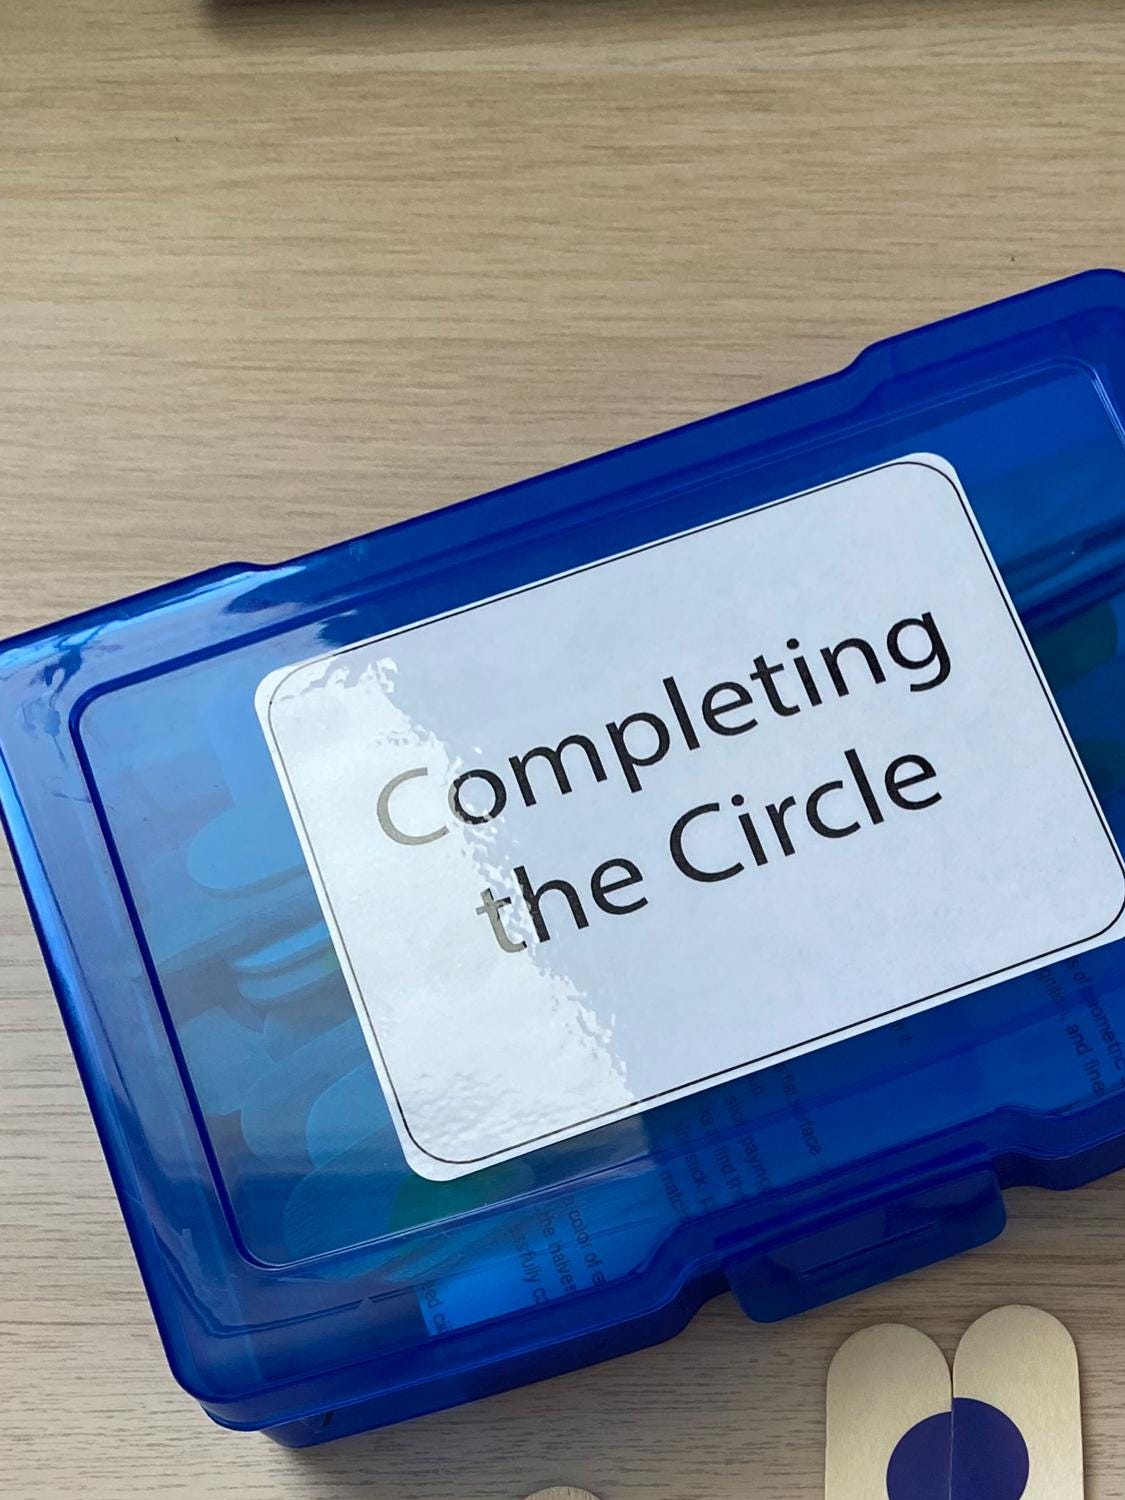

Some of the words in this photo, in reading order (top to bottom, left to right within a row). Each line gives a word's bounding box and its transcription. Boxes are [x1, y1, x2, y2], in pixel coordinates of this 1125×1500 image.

[375, 610, 952, 846] Completing
[475, 858, 649, 955] the
[668, 748, 943, 884] Circle
[1066, 1024, 1093, 1056] and
[567, 1209, 593, 1249] color
[583, 1251, 604, 1269] of
